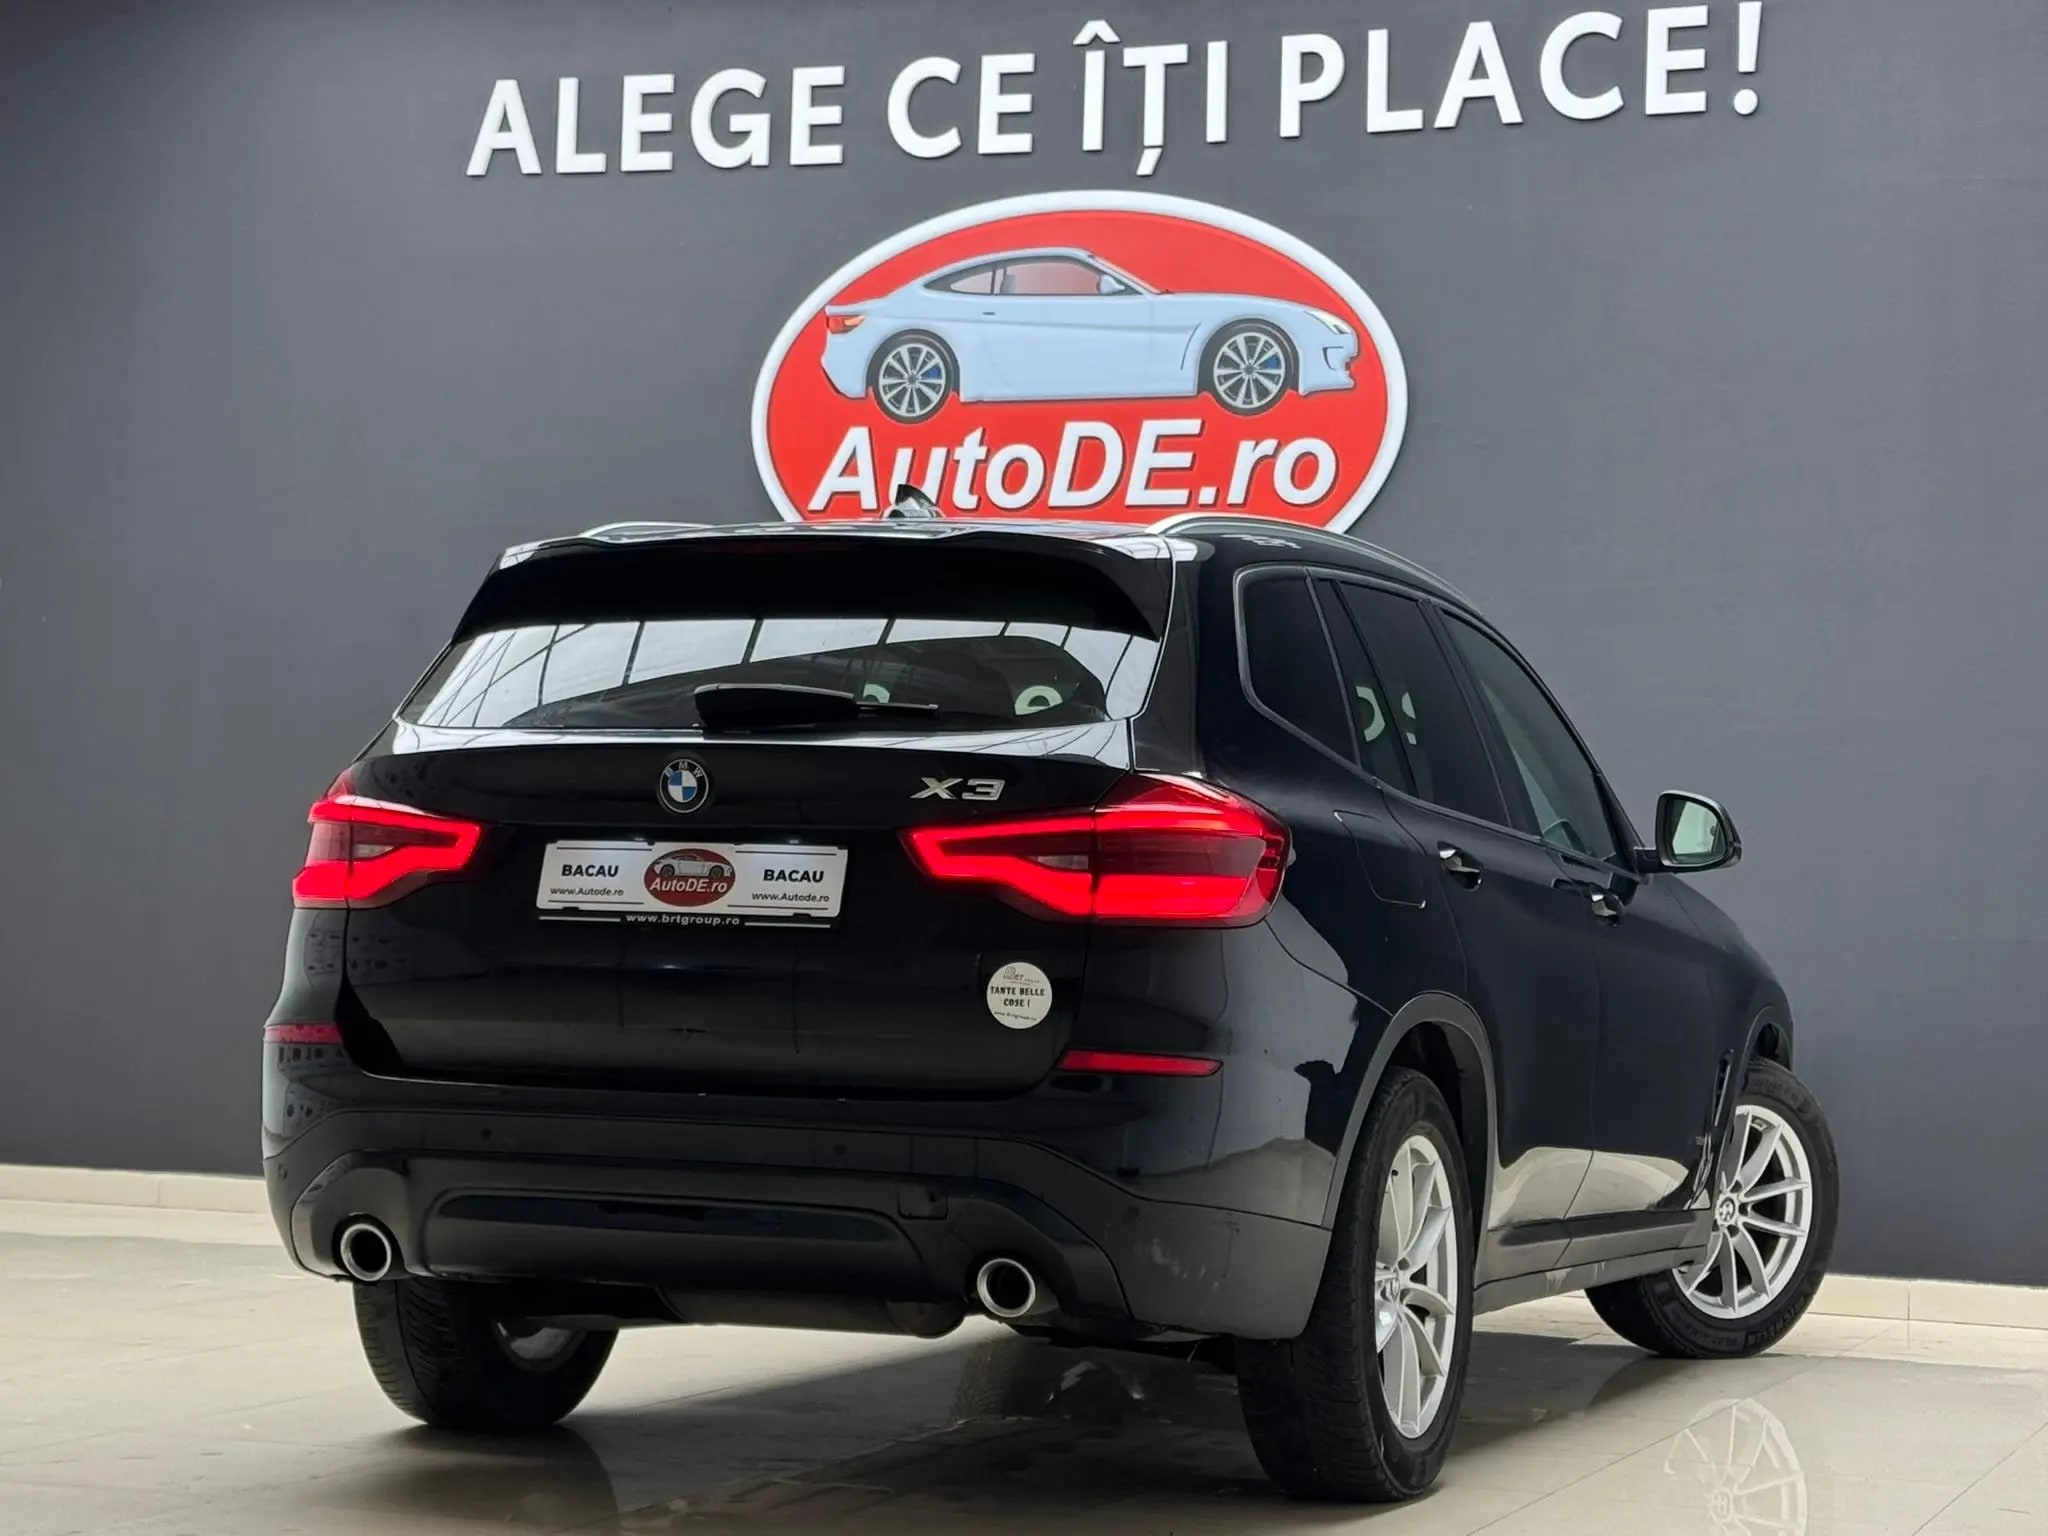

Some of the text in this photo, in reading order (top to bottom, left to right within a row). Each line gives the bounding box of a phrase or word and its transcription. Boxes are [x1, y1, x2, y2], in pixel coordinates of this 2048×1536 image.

[466, 66, 845, 177] ALEGE
[887, 53, 1035, 159] CE
[1279, 1, 1763, 137] PLACE!
[808, 418, 1338, 512] AutoDE.ro
[664, 761, 703, 778] BMW
[910, 777, 1006, 801] X3
[561, 864, 619, 877] BACAU
[763, 869, 824, 883] BACAU
[550, 887, 624, 896] www.Autode.ro
[650, 877, 728, 893] AutoDE.ro
[752, 892, 829, 902] www.Autode.ro
[626, 914, 740, 926] www.brtgroup.ro
[990, 986, 1046, 996] TANTE BELLE
[1003, 998, 1024, 1007] COSE
